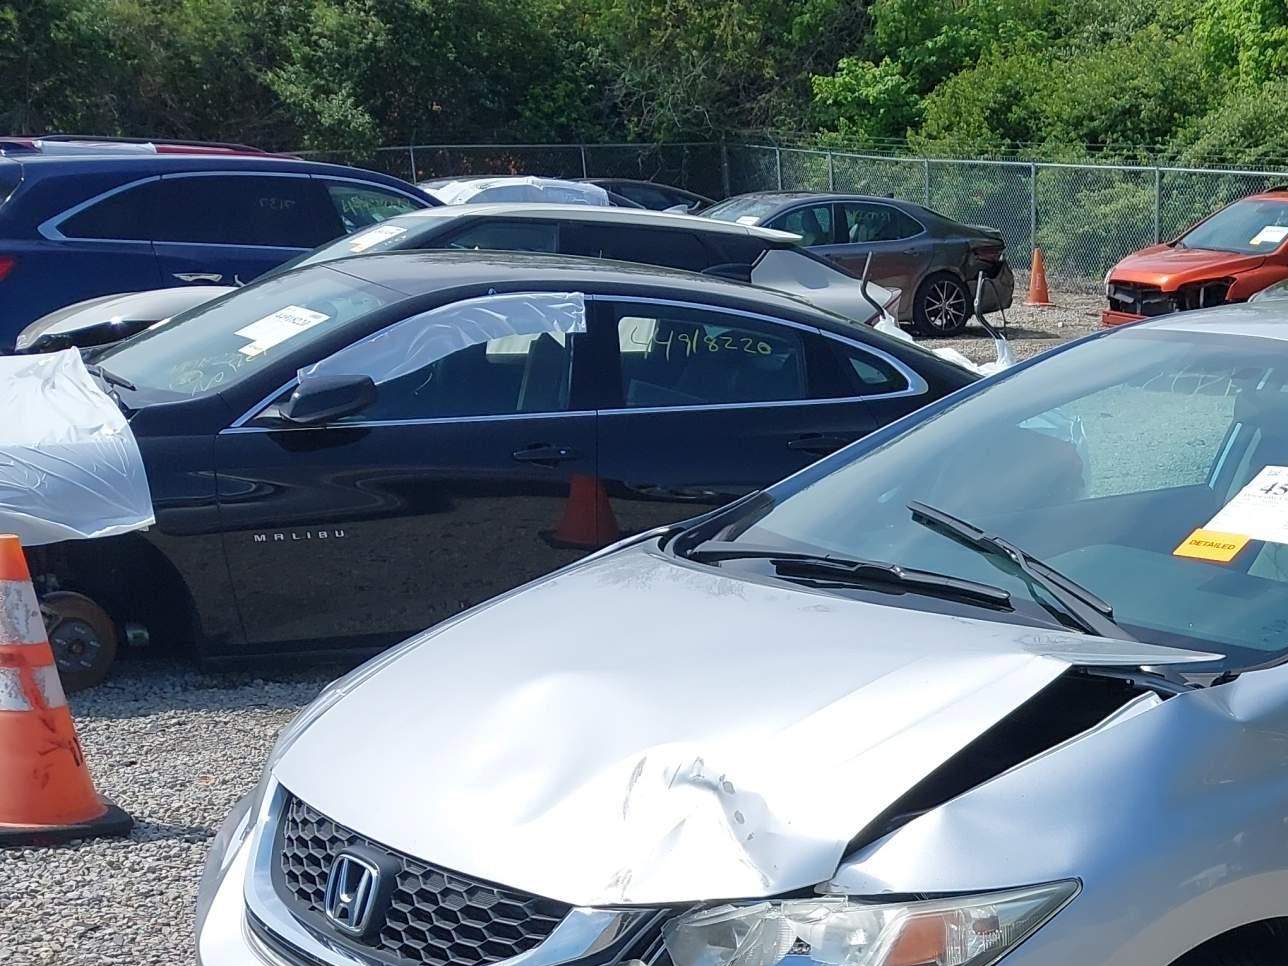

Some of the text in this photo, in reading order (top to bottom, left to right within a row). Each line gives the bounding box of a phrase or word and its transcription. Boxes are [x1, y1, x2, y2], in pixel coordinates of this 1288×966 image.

[630, 325, 772, 361] 44918220
[253, 529, 345, 542] MALIBU
[1188, 539, 1236, 550] DETAILED
